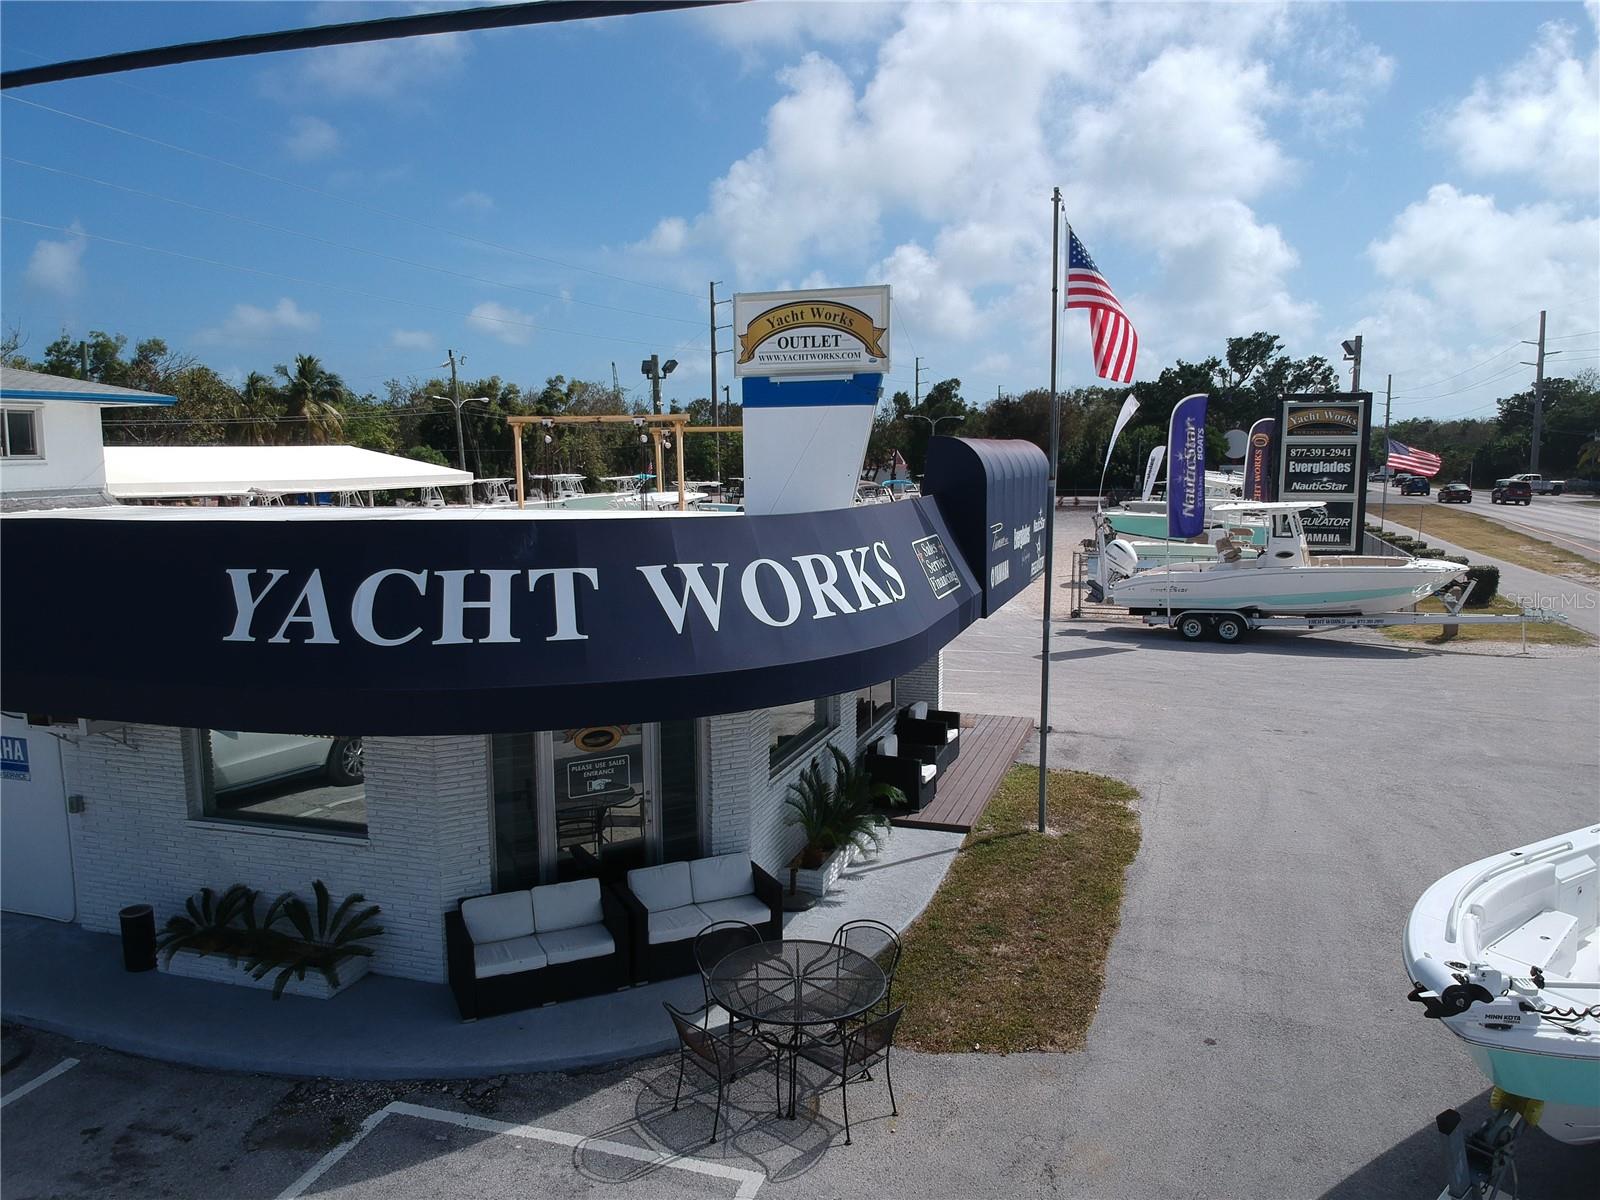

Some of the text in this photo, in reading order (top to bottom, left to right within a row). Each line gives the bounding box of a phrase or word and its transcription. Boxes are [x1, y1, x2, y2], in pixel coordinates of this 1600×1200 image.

[766, 307, 855, 329] Yacht Works
[777, 334, 842, 349] OUTLET
[758, 351, 861, 362] WWW.YACHTWORKS.COM
[1290, 411, 1357, 425] Yacht Works
[1290, 448, 1351, 457] 877-391-2941
[1289, 461, 1351, 474] Everglades
[1253, 449, 1263, 501] CHT WORKS
[1291, 482, 1348, 491] NauticStar
[1299, 517, 1351, 527] GULATOR
[921, 542, 938, 557] Sales
[926, 558, 947, 574] Service
[221, 541, 907, 646] YACHT WORKS
[0, 738, 24, 761] HA
[571, 763, 592, 772] PLEASE
[609, 759, 626, 767] SALES
[583, 768, 615, 778] ENTRANCE
